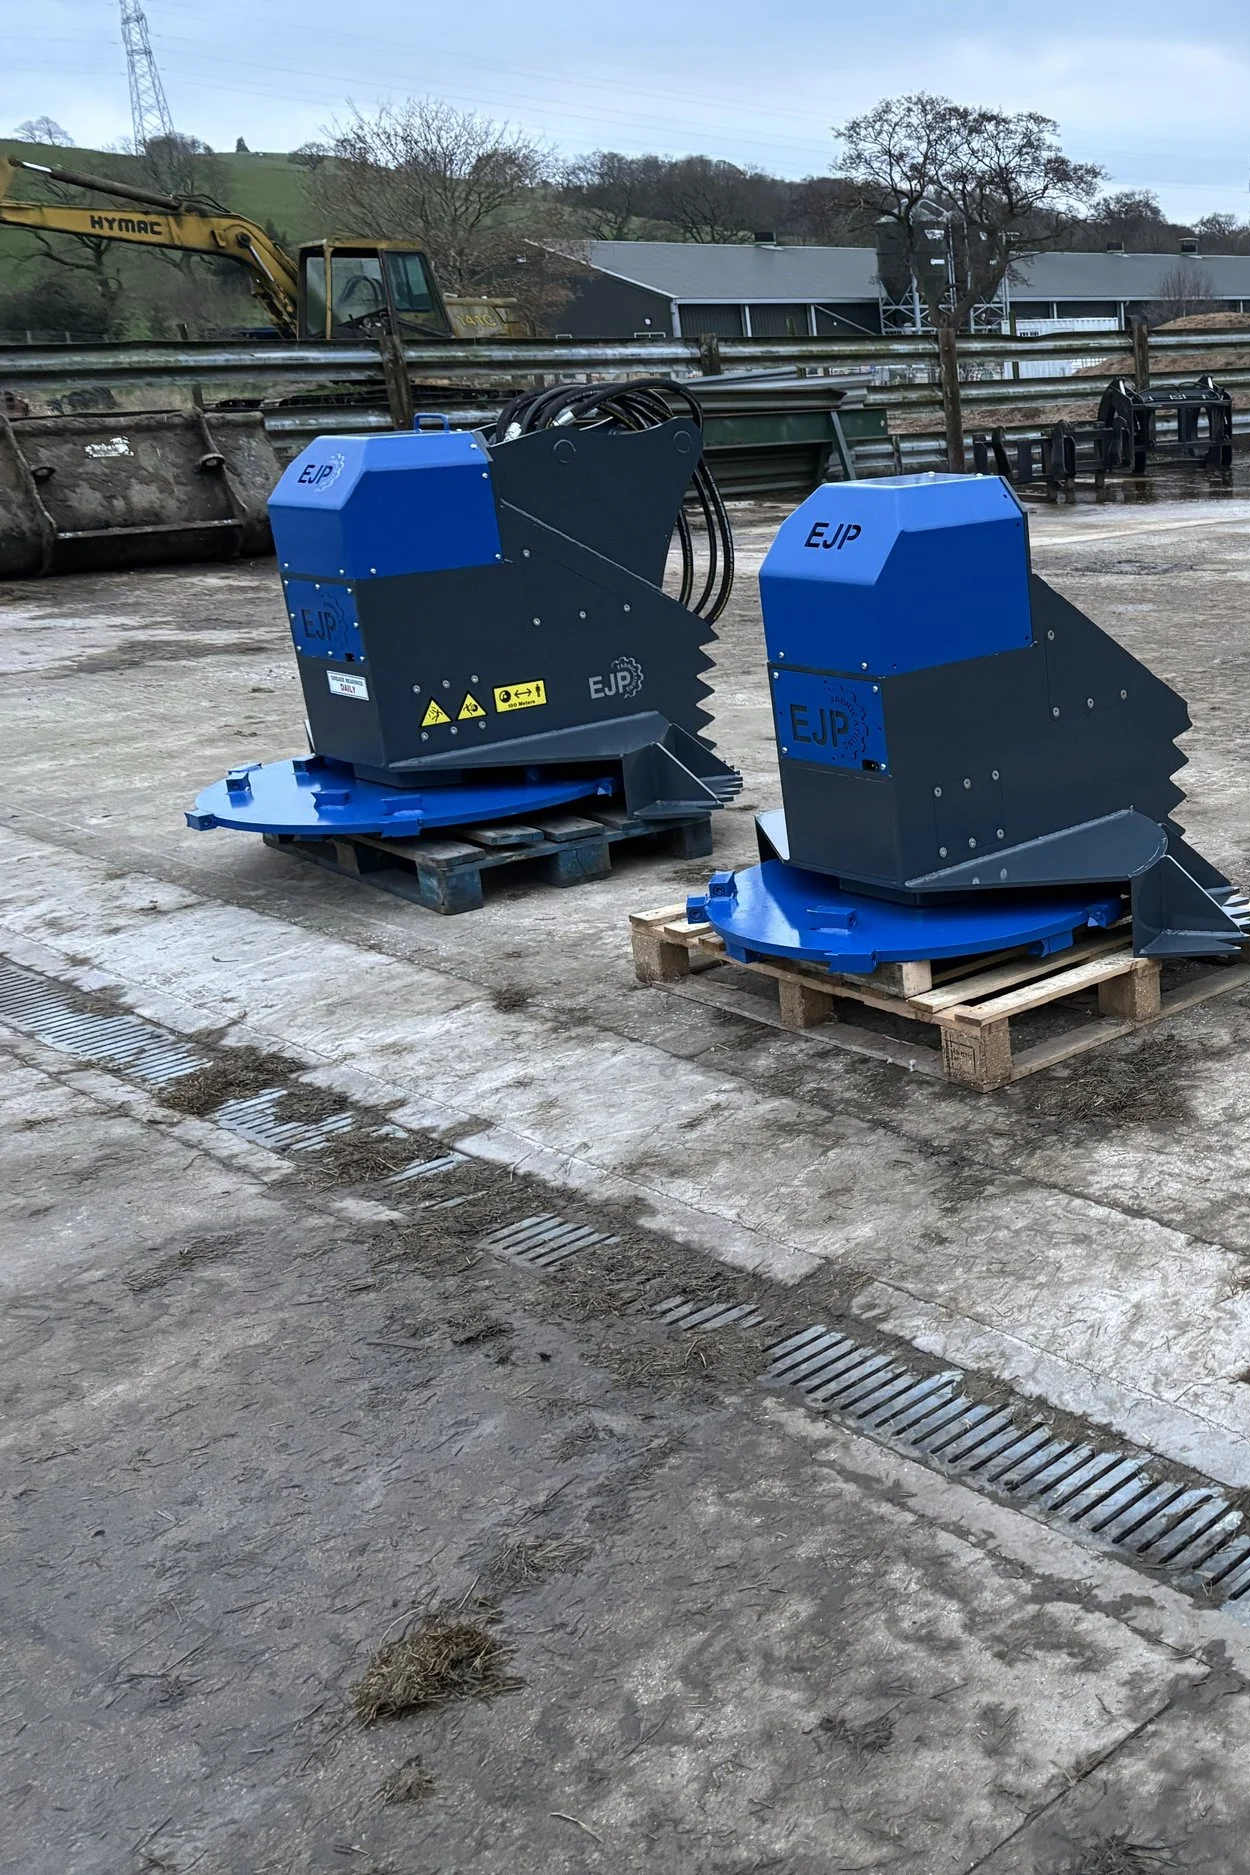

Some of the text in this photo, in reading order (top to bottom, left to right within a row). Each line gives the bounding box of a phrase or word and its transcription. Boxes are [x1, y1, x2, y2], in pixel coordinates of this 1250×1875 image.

[89, 214, 163, 236] HYMAC
[297, 464, 334, 485] EJP
[804, 521, 862, 550] EJP
[301, 608, 337, 641] EJP
[340, 683, 356, 694] DAILY
[588, 670, 631, 699] EJP
[789, 703, 849, 749] EJP
